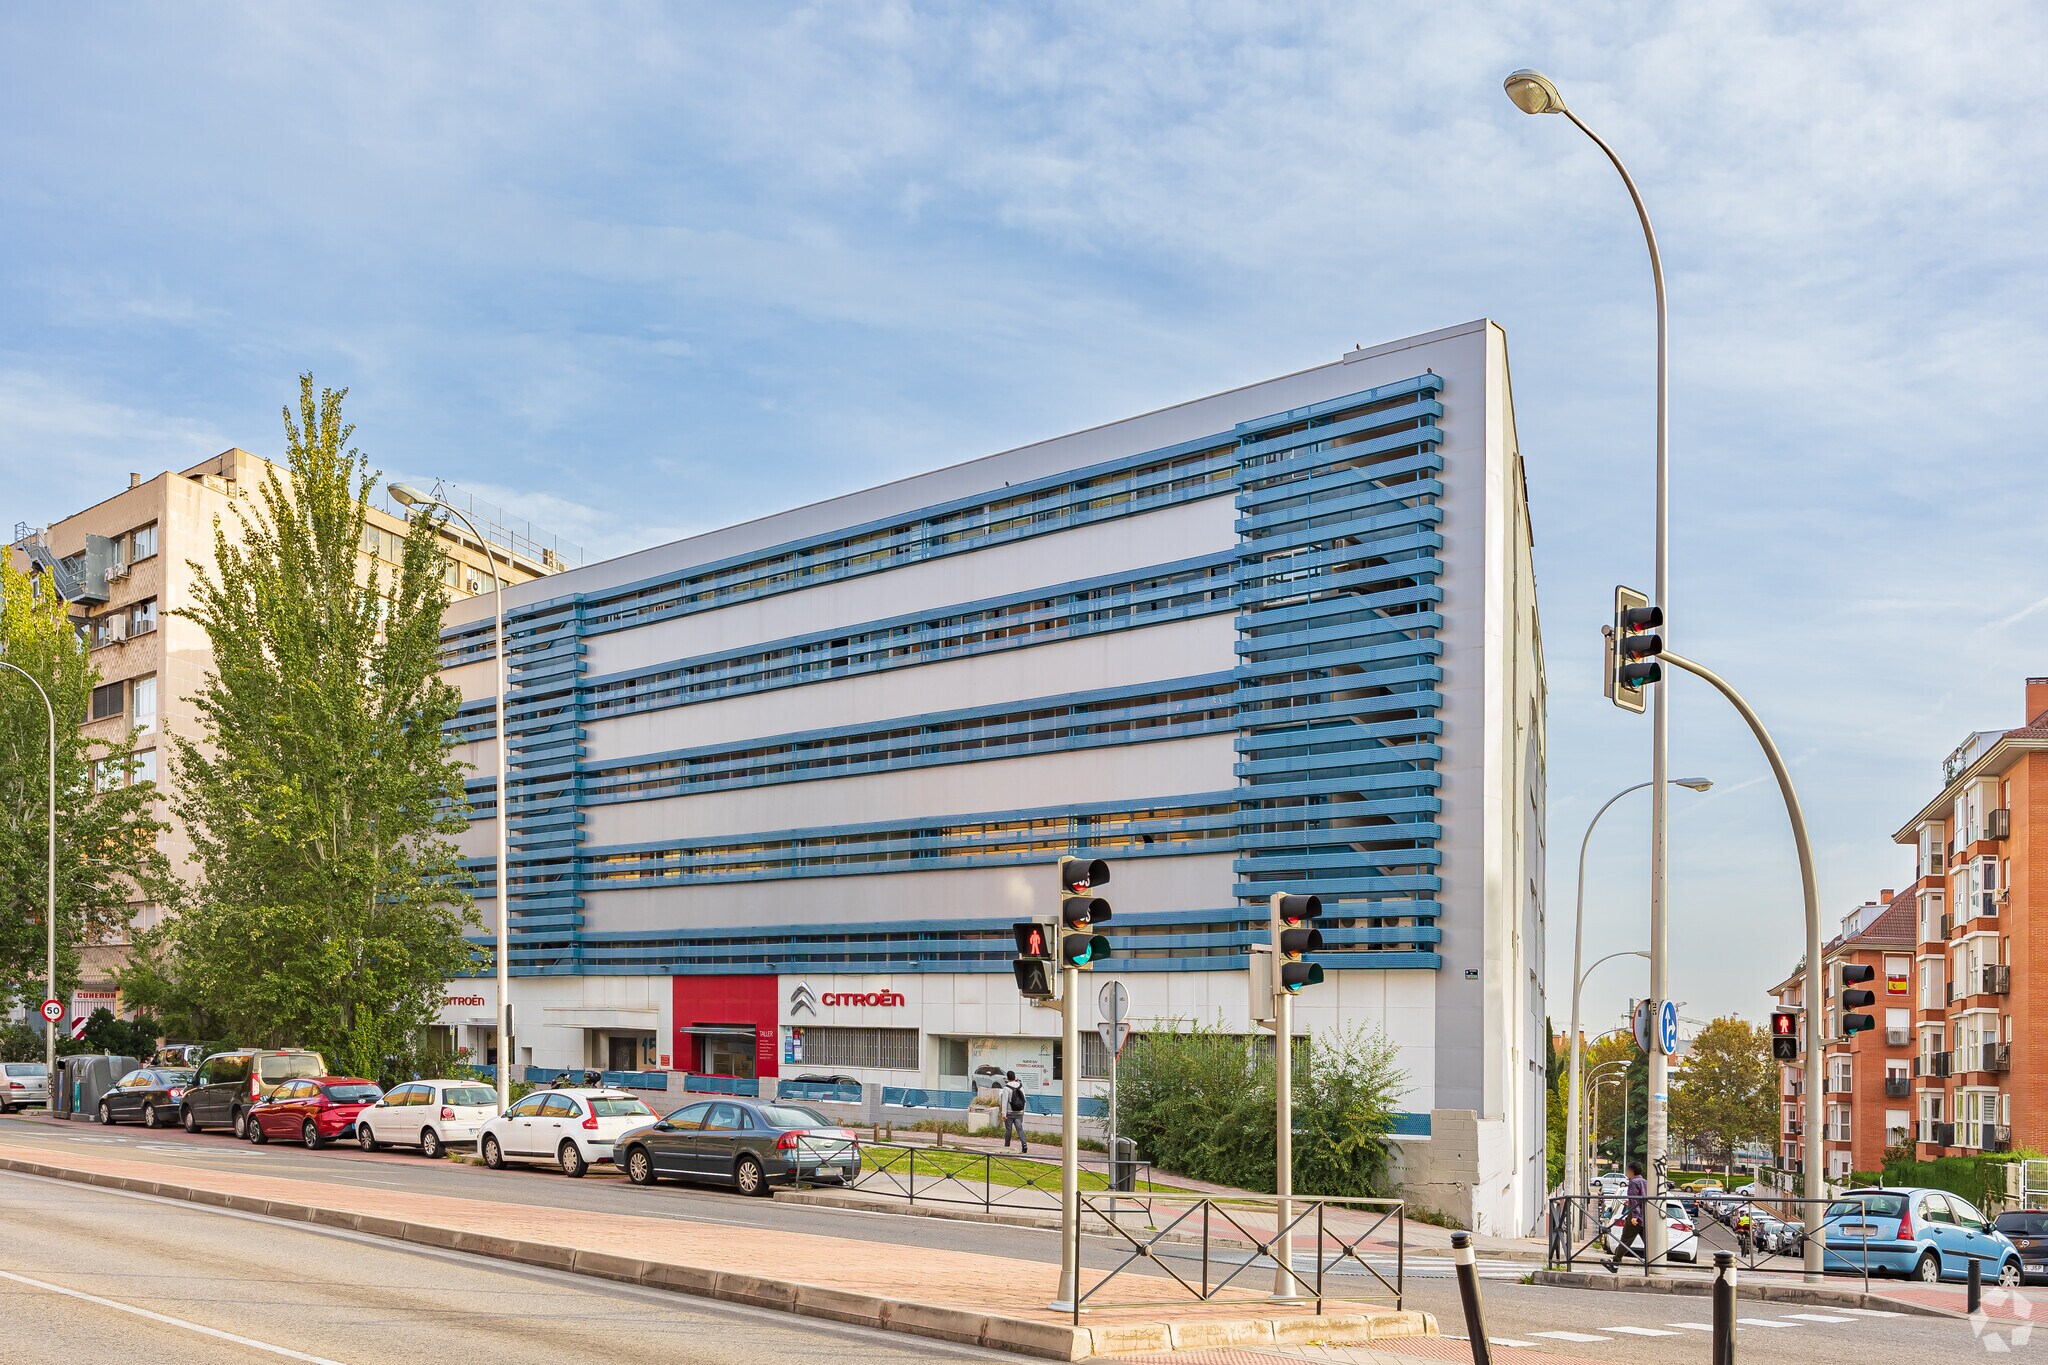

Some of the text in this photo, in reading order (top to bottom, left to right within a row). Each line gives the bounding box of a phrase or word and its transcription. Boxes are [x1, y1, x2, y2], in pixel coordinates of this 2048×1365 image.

[822, 989, 904, 1007] CITROËN
[46, 1007, 60, 1015] 50
[642, 1038, 656, 1065] 15
